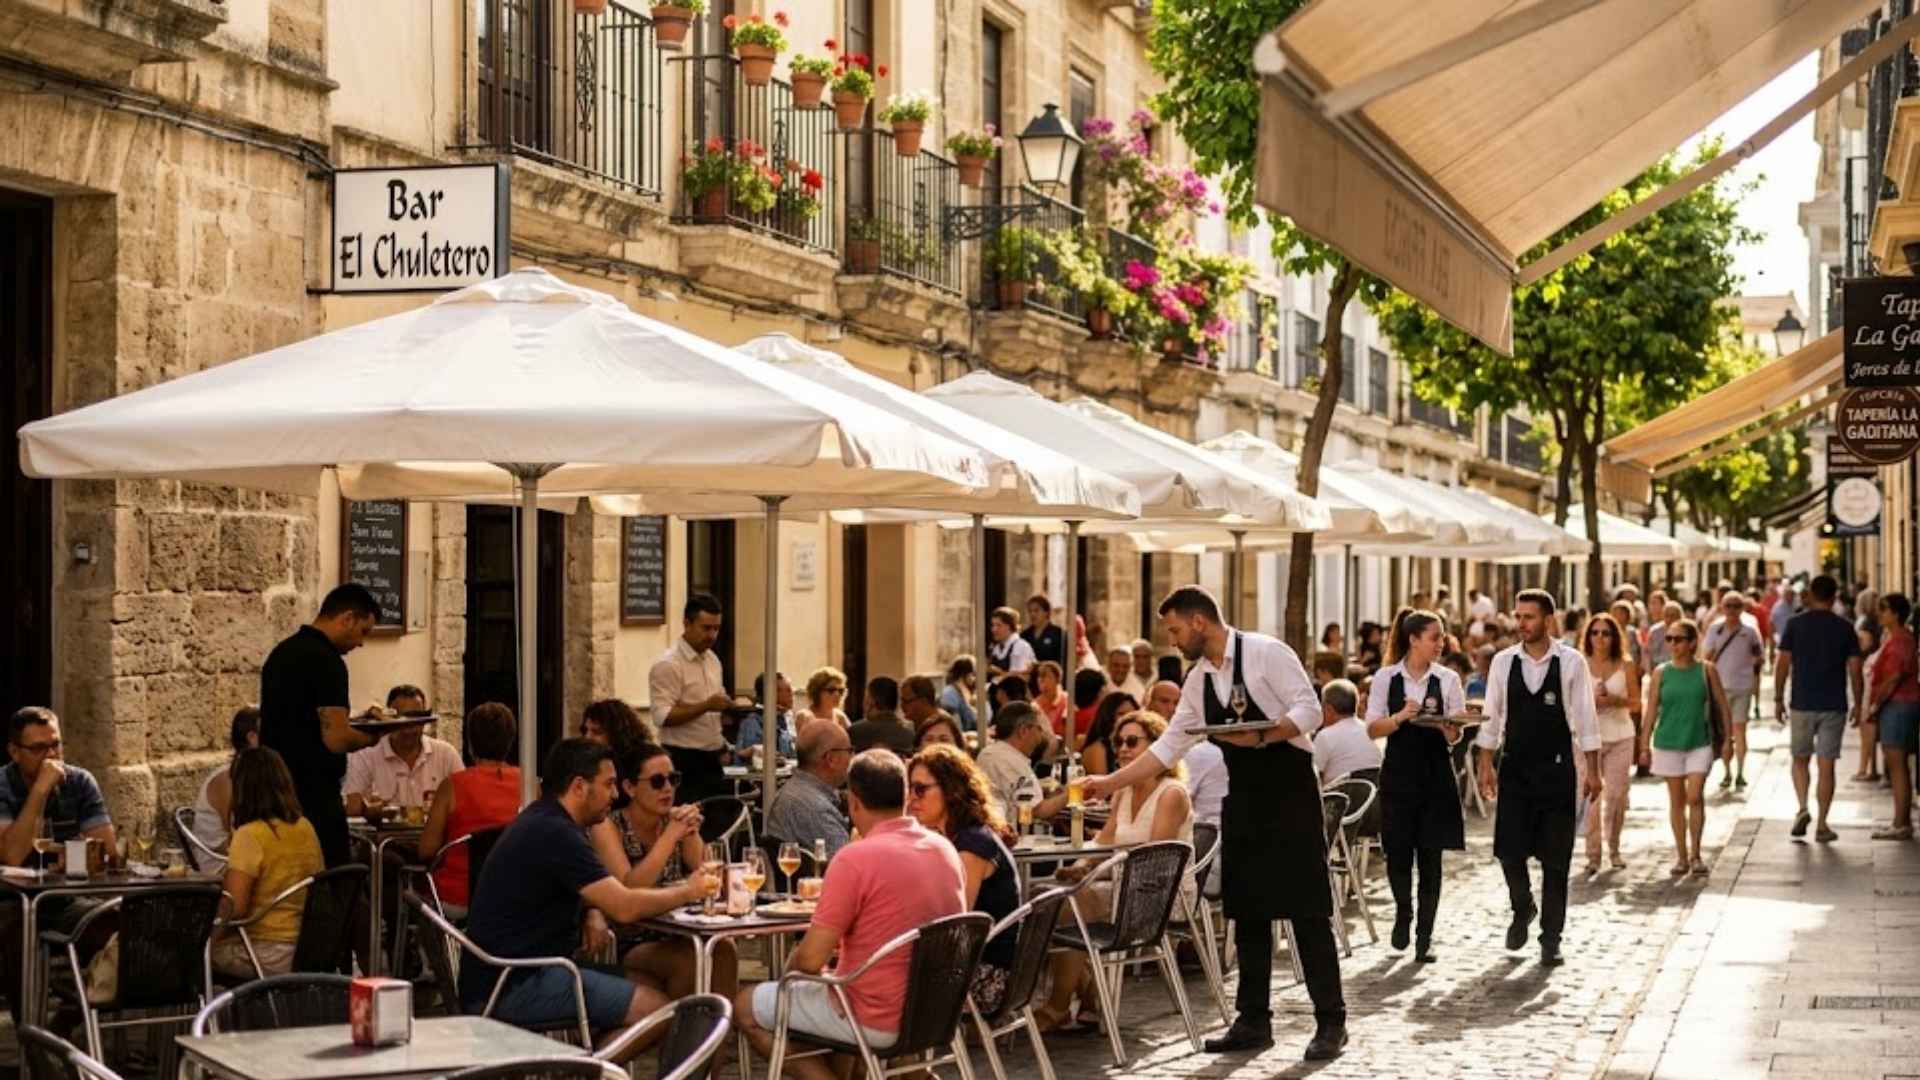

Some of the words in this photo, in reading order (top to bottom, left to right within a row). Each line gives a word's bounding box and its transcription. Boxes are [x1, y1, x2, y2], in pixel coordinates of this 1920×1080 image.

[387, 179, 444, 221] Bar
[340, 232, 362, 279] El
[373, 230, 490, 279] Chuletero
[1852, 325, 1885, 346] La
[1892, 358, 1911, 375] de
[1846, 405, 1900, 421] TAPERÍA
[1902, 407, 1919, 421] LA
[1846, 424, 1919, 439] GADITANA
